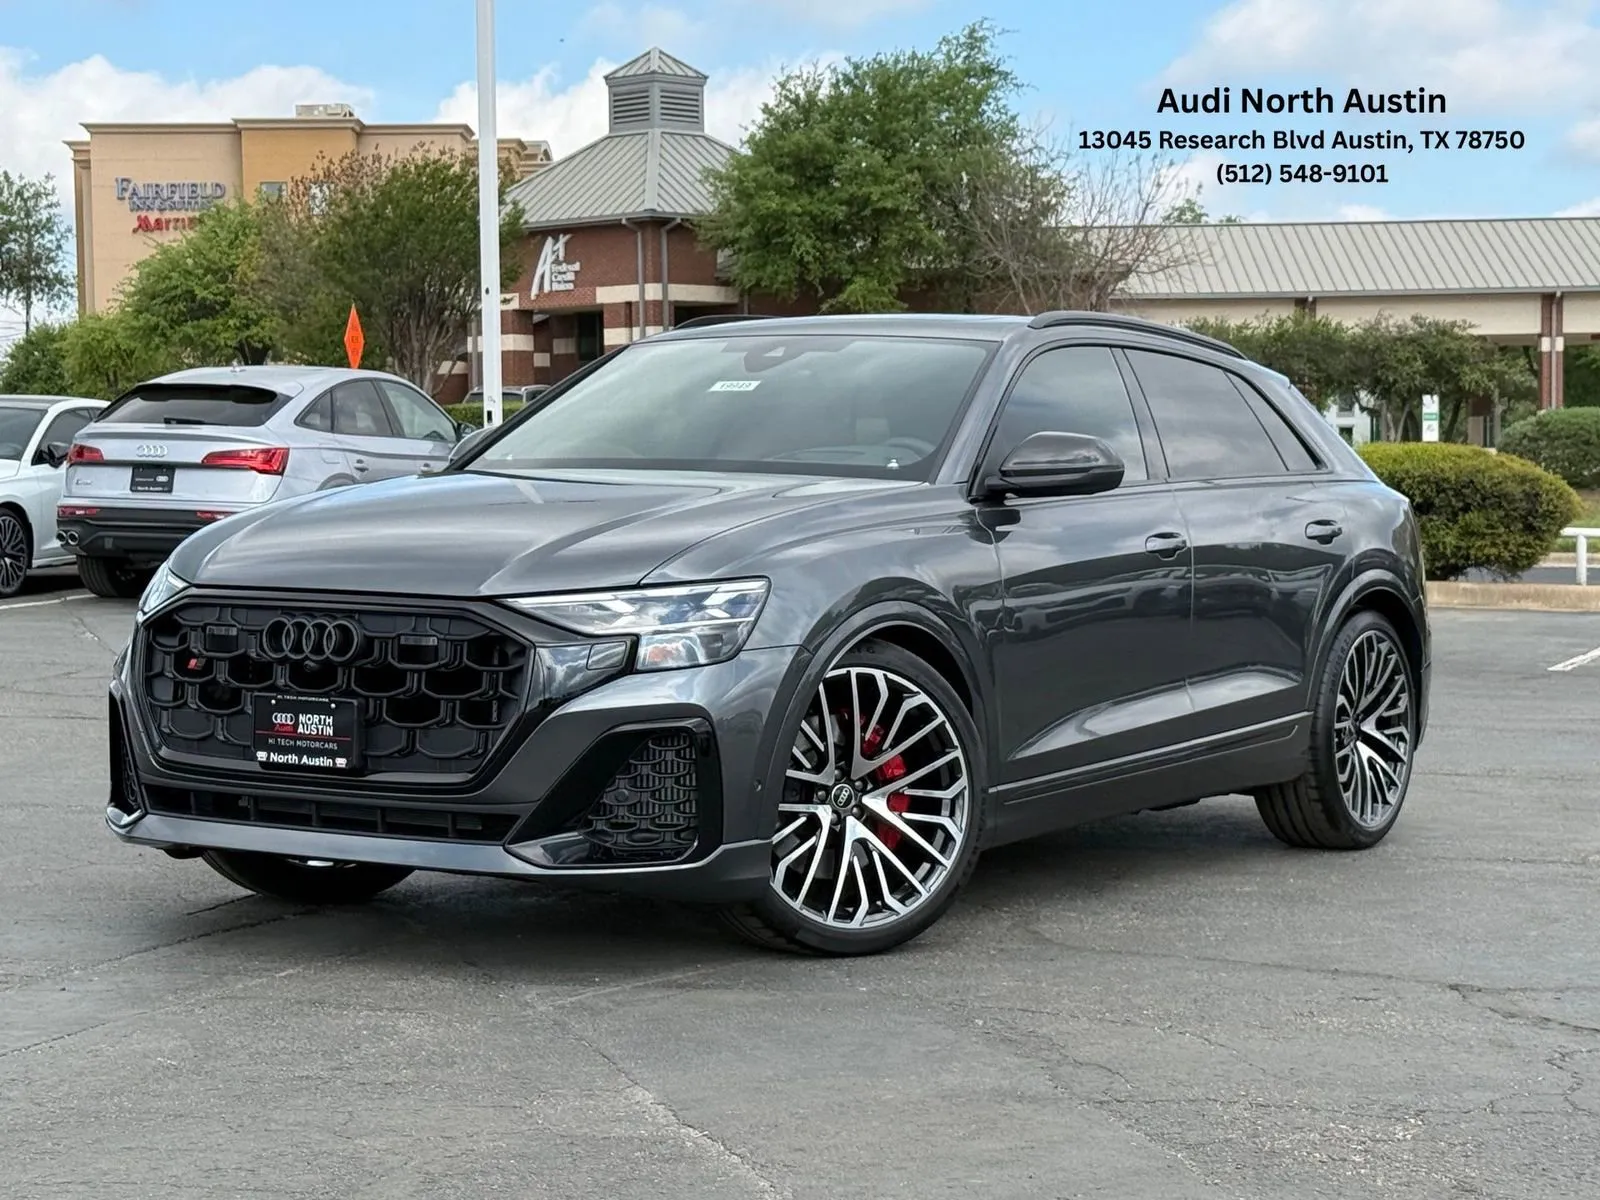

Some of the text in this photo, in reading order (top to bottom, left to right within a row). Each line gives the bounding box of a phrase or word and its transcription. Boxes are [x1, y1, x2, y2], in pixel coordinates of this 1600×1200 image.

[115, 176, 226, 201] FAIRFIELD
[298, 713, 334, 726] NORTH
[297, 723, 334, 737] AUSTIN
[277, 738, 295, 747] TECH
[297, 740, 338, 750] MOTORCARS
[269, 752, 333, 768] North Austin
